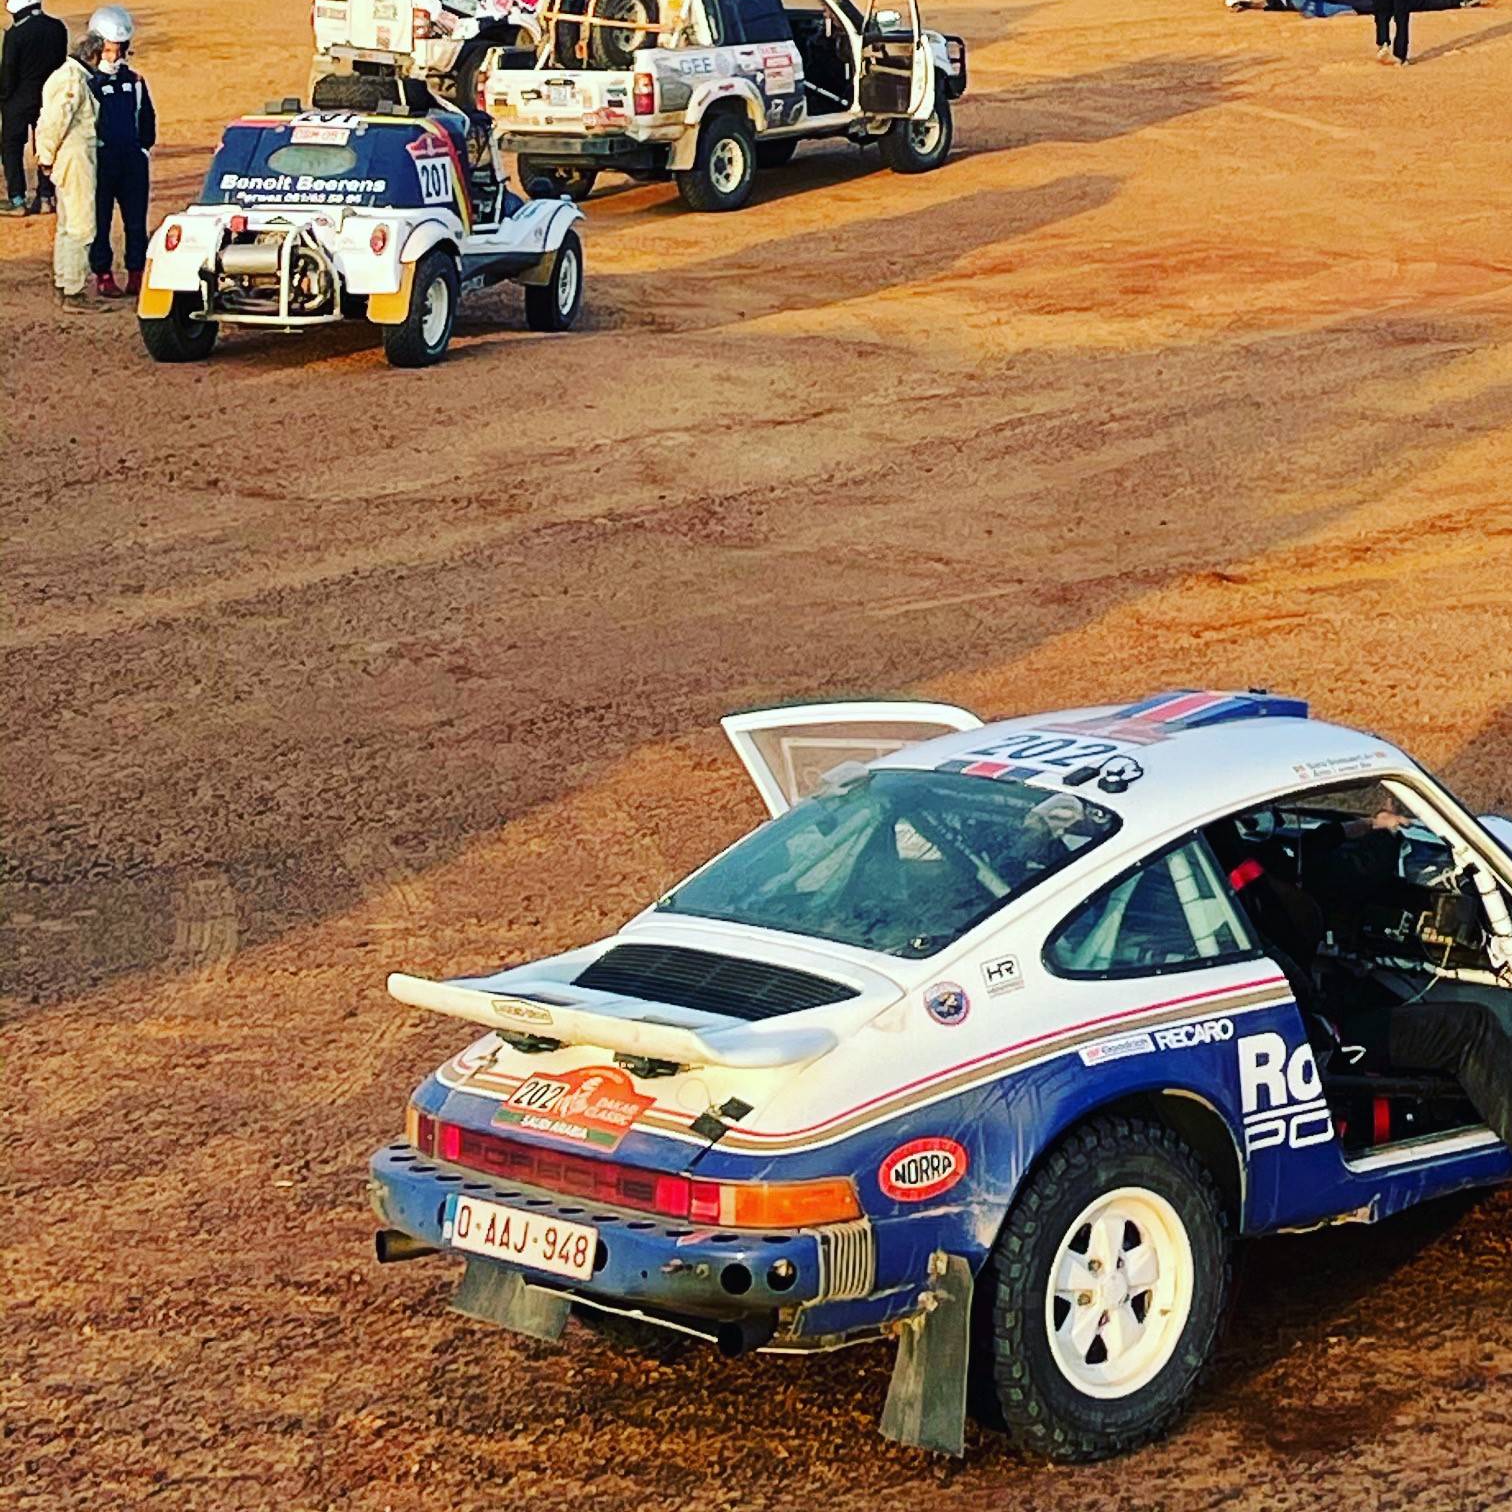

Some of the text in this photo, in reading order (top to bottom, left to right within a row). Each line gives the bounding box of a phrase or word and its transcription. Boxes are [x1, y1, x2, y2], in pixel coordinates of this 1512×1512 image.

[680, 57, 713, 76] GEE
[420, 163, 449, 198] 201
[966, 734, 1118, 767] 202
[1154, 1018, 1234, 1051] RECARO
[513, 1080, 566, 1109] 202
[520, 1113, 588, 1139] SAUDI ARABIA
